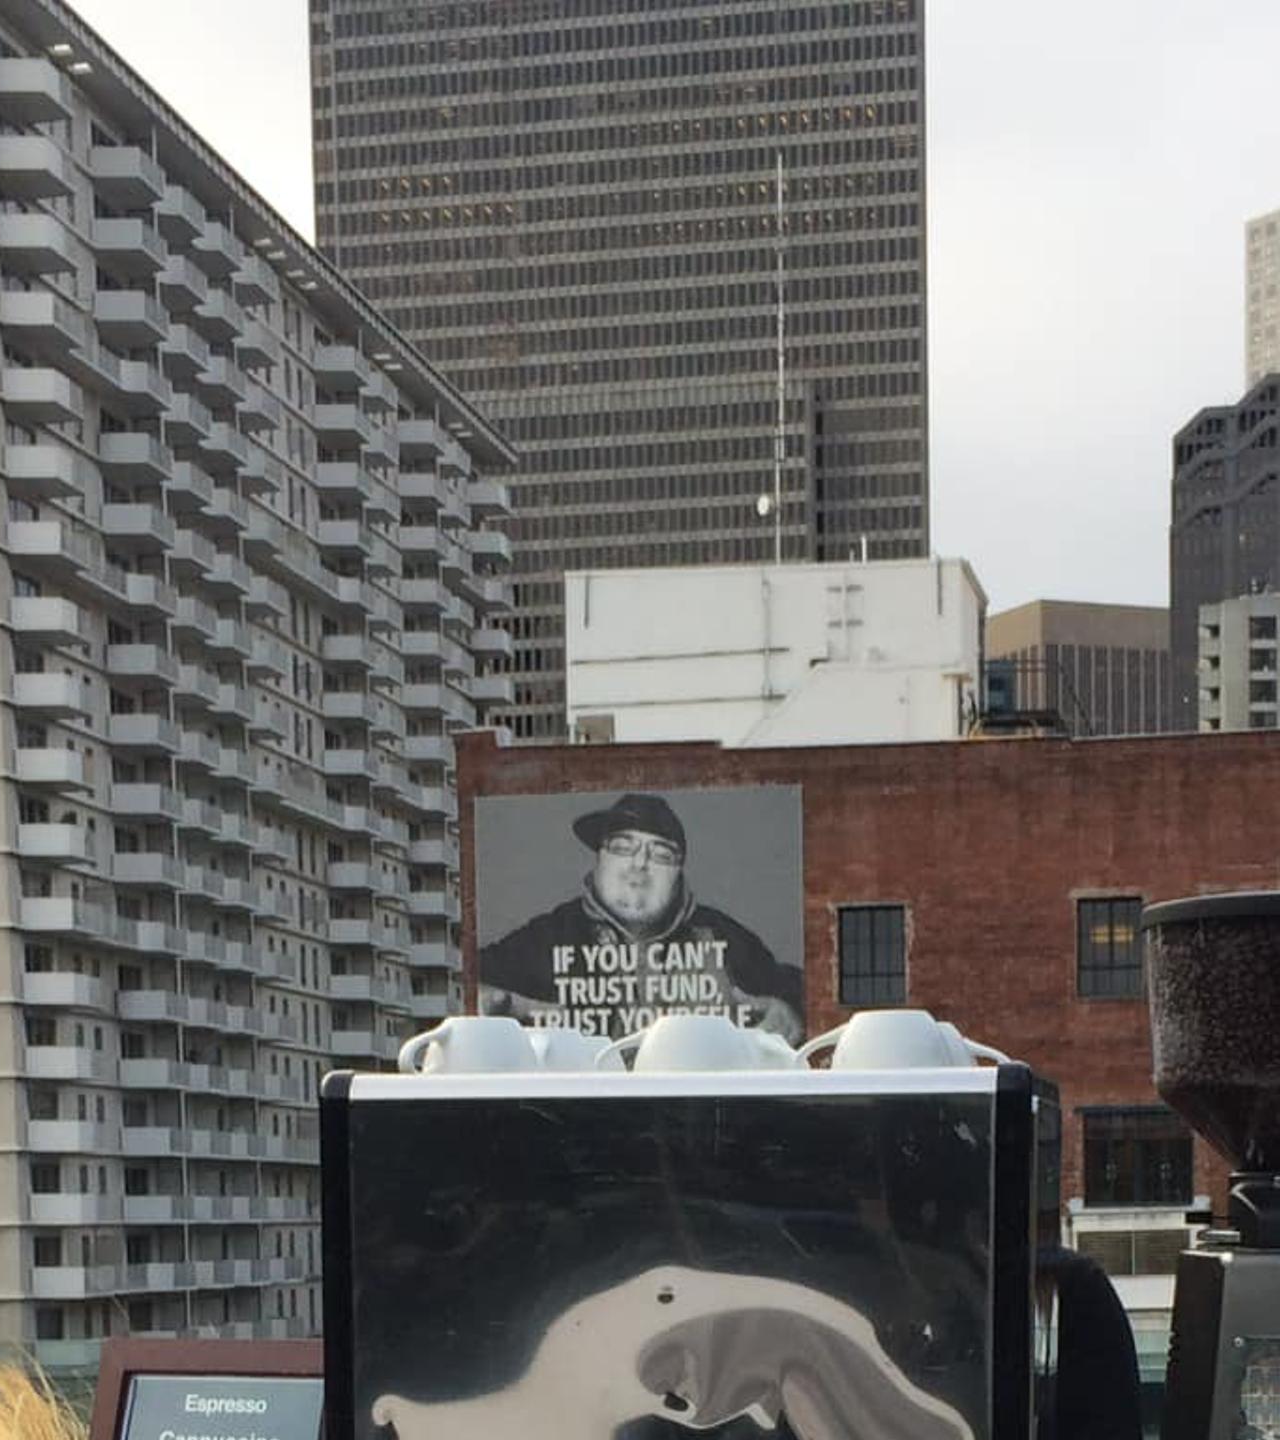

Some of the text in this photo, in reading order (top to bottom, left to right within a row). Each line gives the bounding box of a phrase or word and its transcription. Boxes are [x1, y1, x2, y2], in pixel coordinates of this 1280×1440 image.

[552, 941, 728, 974] IF YOU CAN'T
[554, 974, 723, 1006] TRUST FUND,
[528, 1007, 612, 1036] TRUST
[184, 1394, 268, 1415] Espresso
